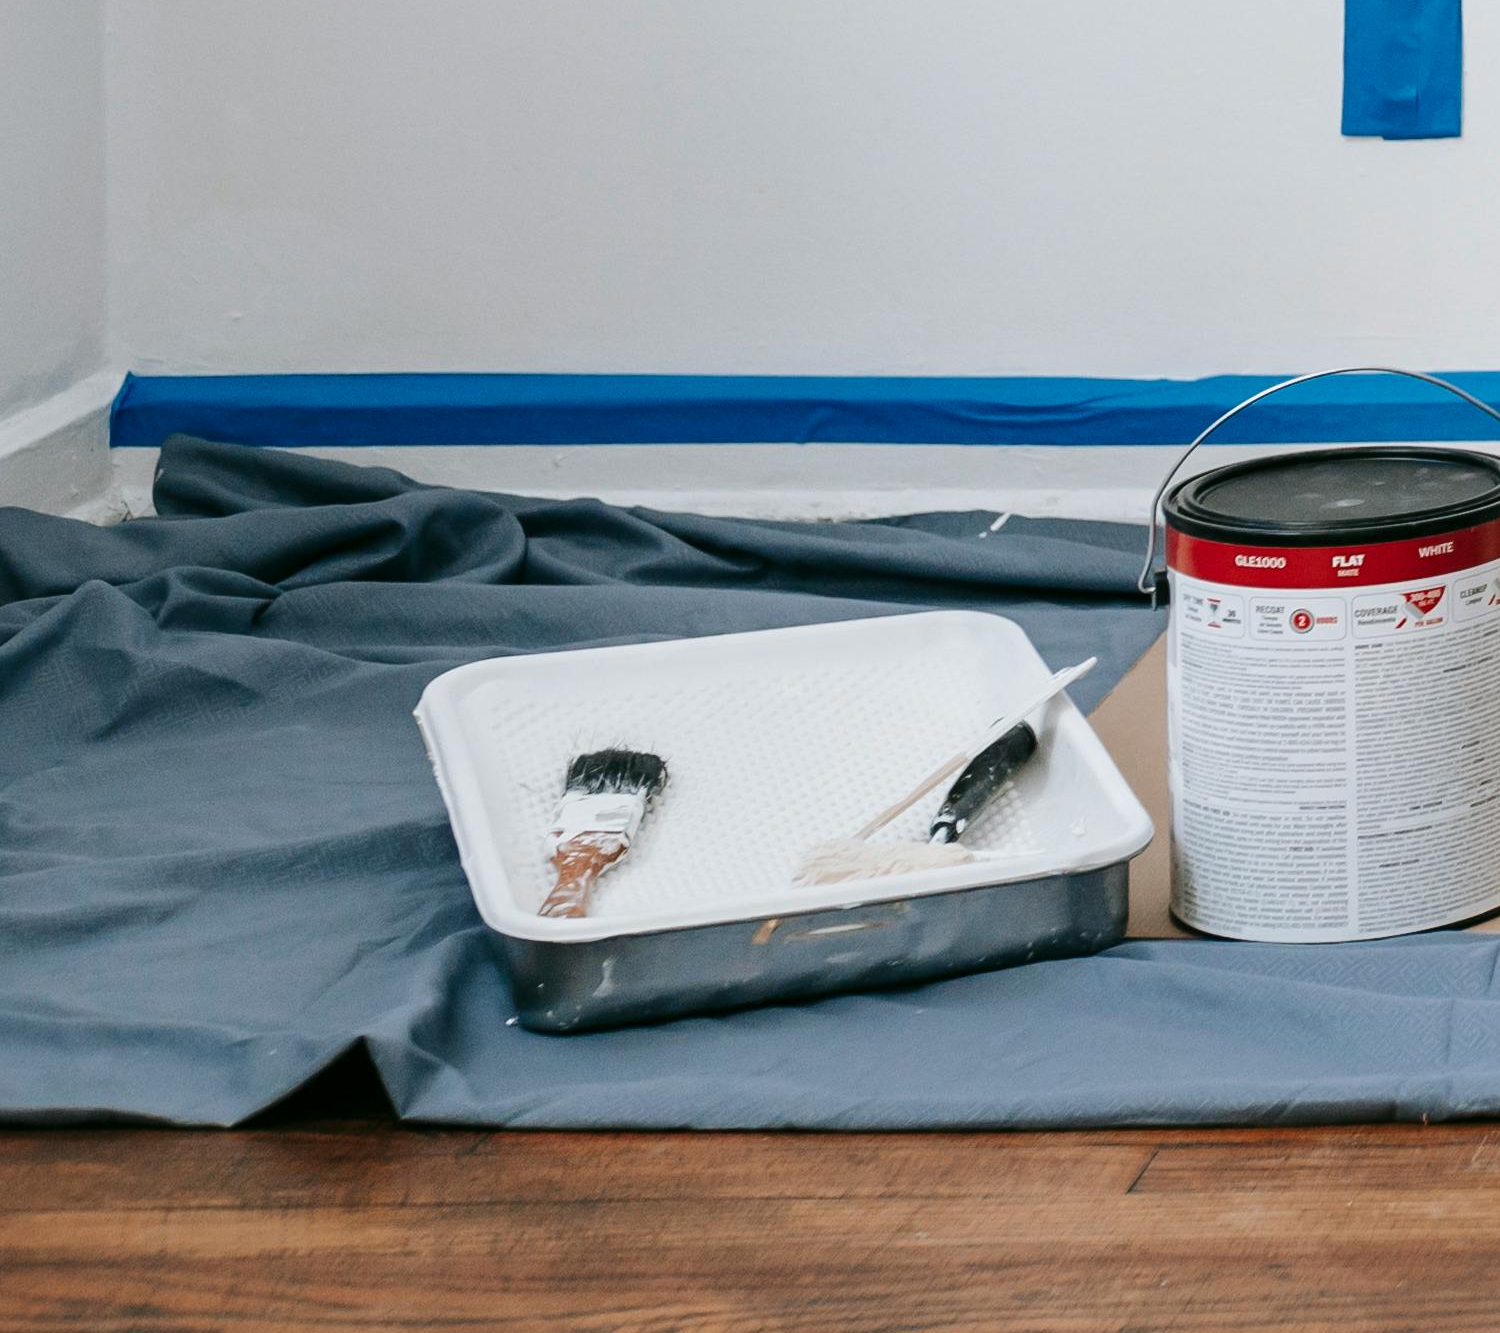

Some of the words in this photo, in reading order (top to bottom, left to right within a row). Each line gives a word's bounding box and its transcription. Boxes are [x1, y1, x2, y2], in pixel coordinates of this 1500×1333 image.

[1418, 541, 1454, 558] WHITE
[1234, 554, 1287, 569] GLE1000
[1331, 553, 1366, 568] FLAT
[1255, 605, 1285, 615] RECOAT
[1354, 605, 1398, 618] COVERAGE
[1298, 616, 1307, 627] 2
